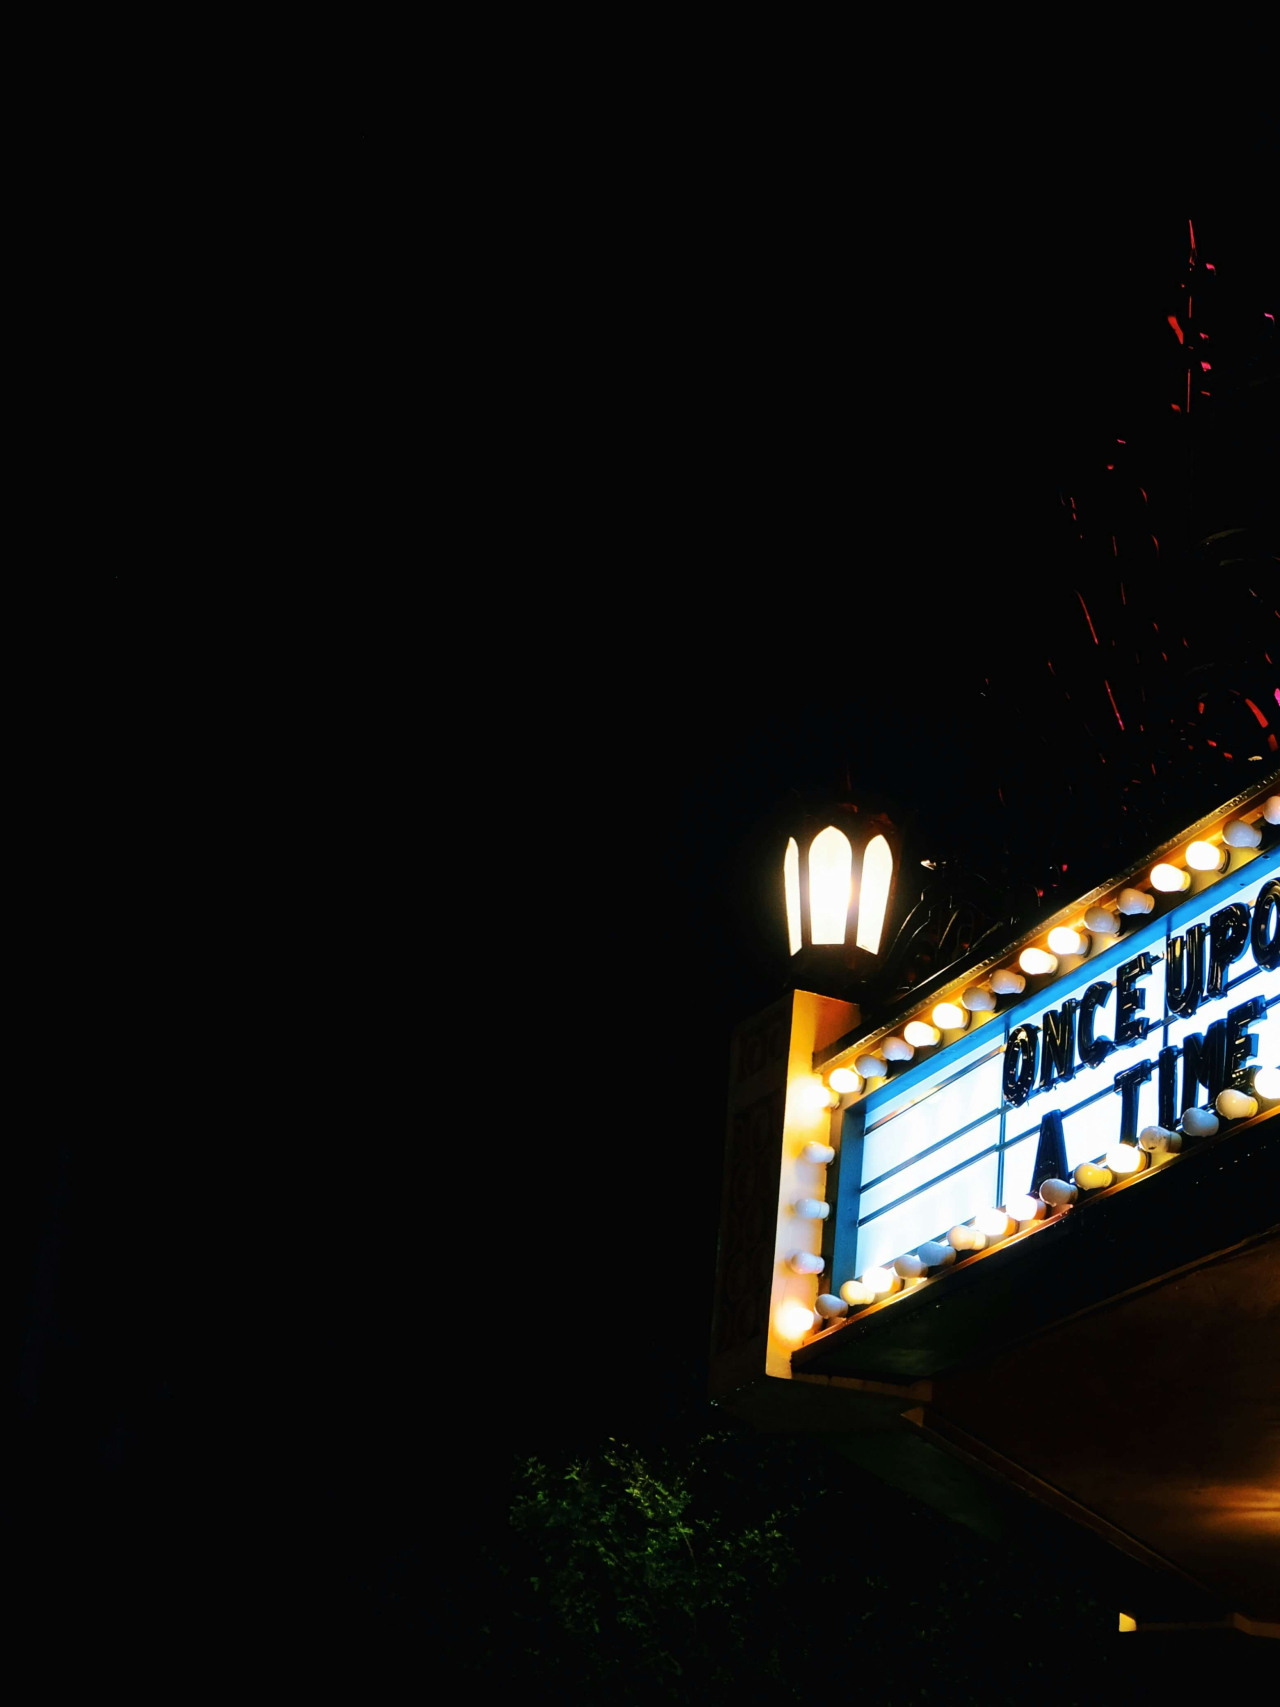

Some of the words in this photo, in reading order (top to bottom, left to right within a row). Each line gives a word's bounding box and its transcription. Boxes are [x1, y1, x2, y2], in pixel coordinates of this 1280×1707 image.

[1002, 951, 1155, 1108] ONCE
[1029, 1109, 1071, 1198] A
[1114, 995, 1268, 1147] TIME
